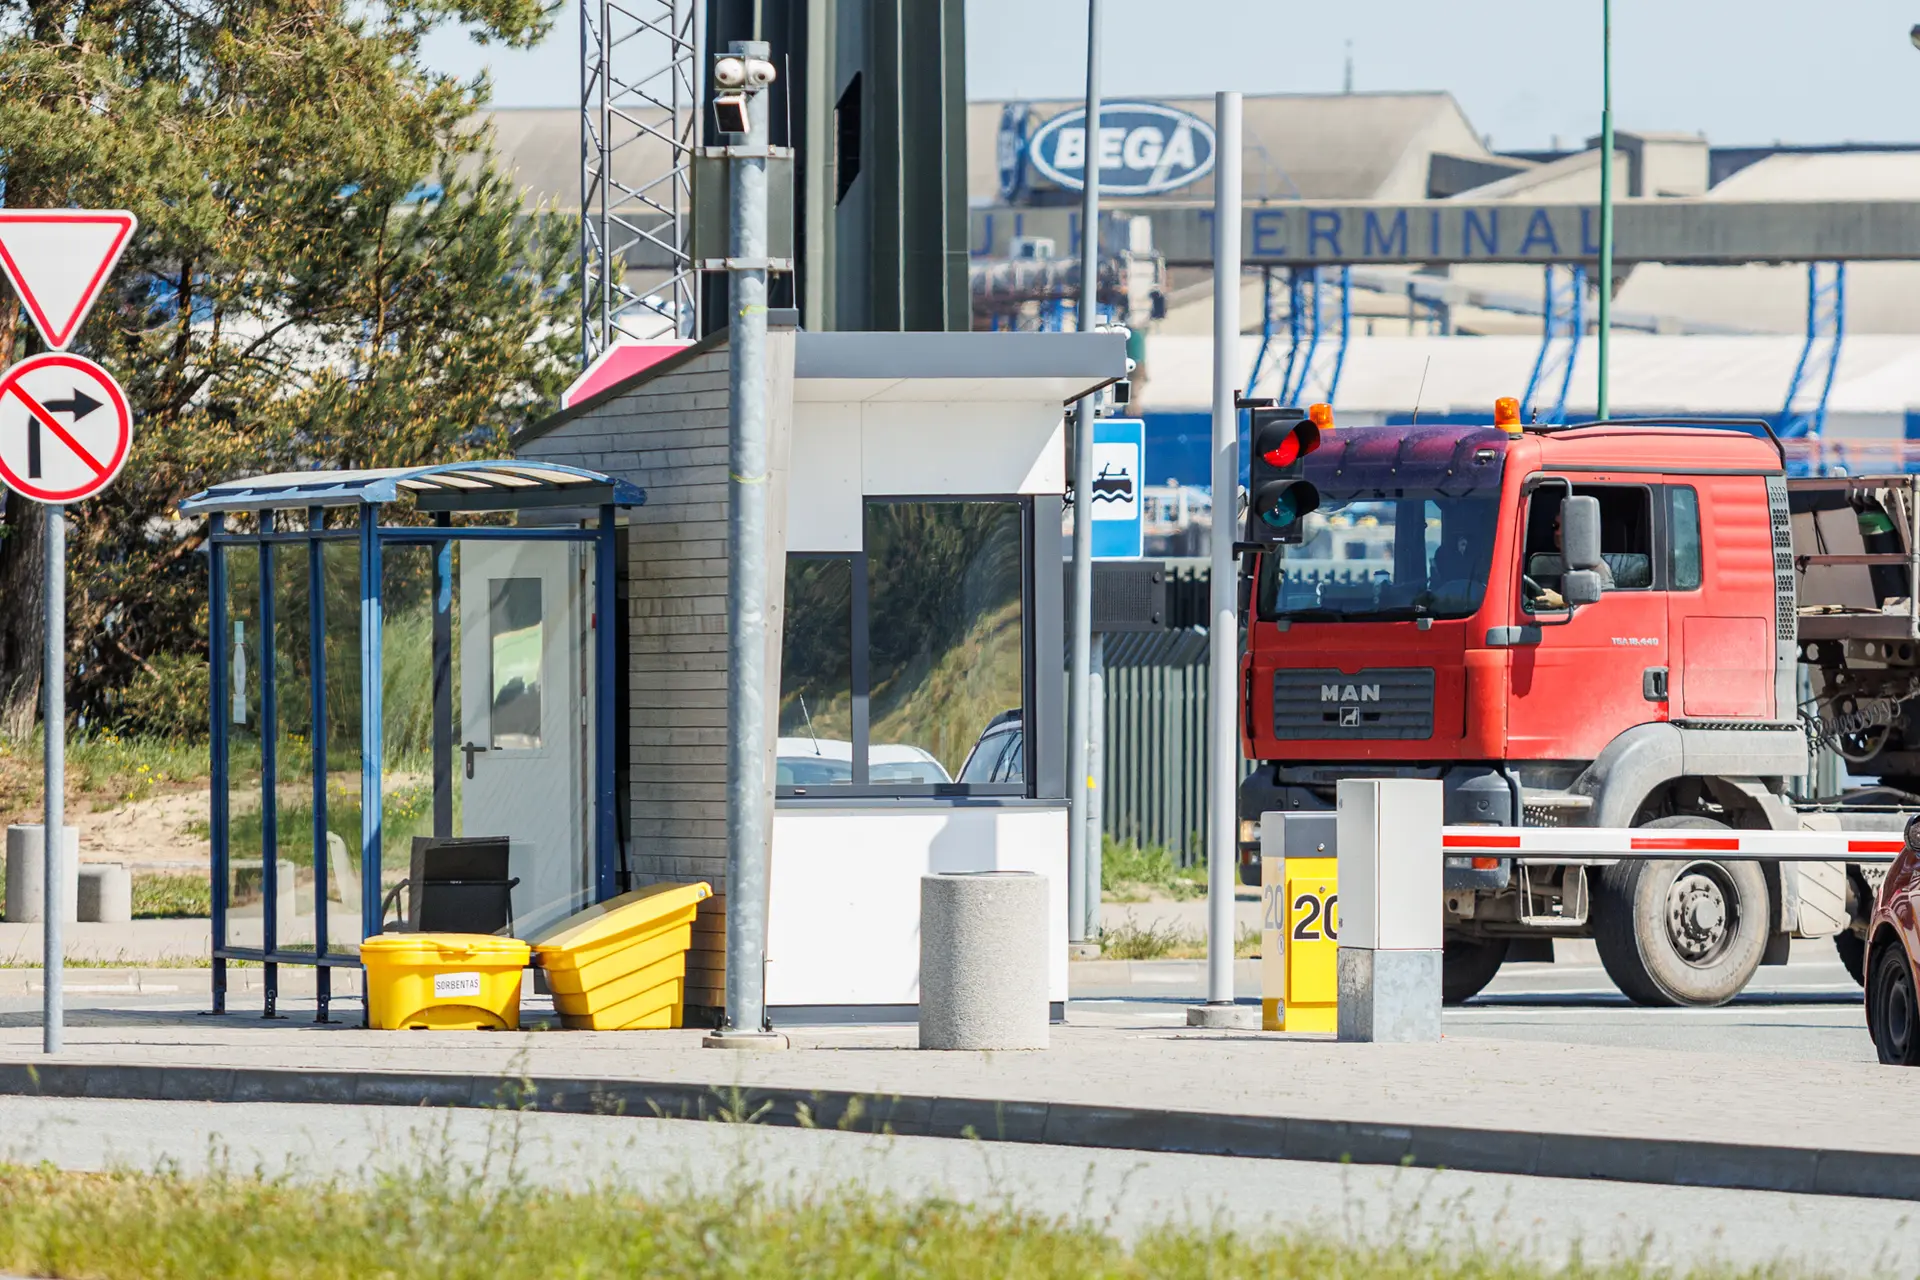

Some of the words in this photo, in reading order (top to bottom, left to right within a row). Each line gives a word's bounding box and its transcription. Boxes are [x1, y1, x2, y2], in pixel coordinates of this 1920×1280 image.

[1053, 123, 1197, 172] BEGA
[1321, 684, 1380, 701] MAN
[1264, 883, 1284, 931] 20
[1293, 893, 1338, 940] 20
[436, 979, 479, 991] SORBENTAS
